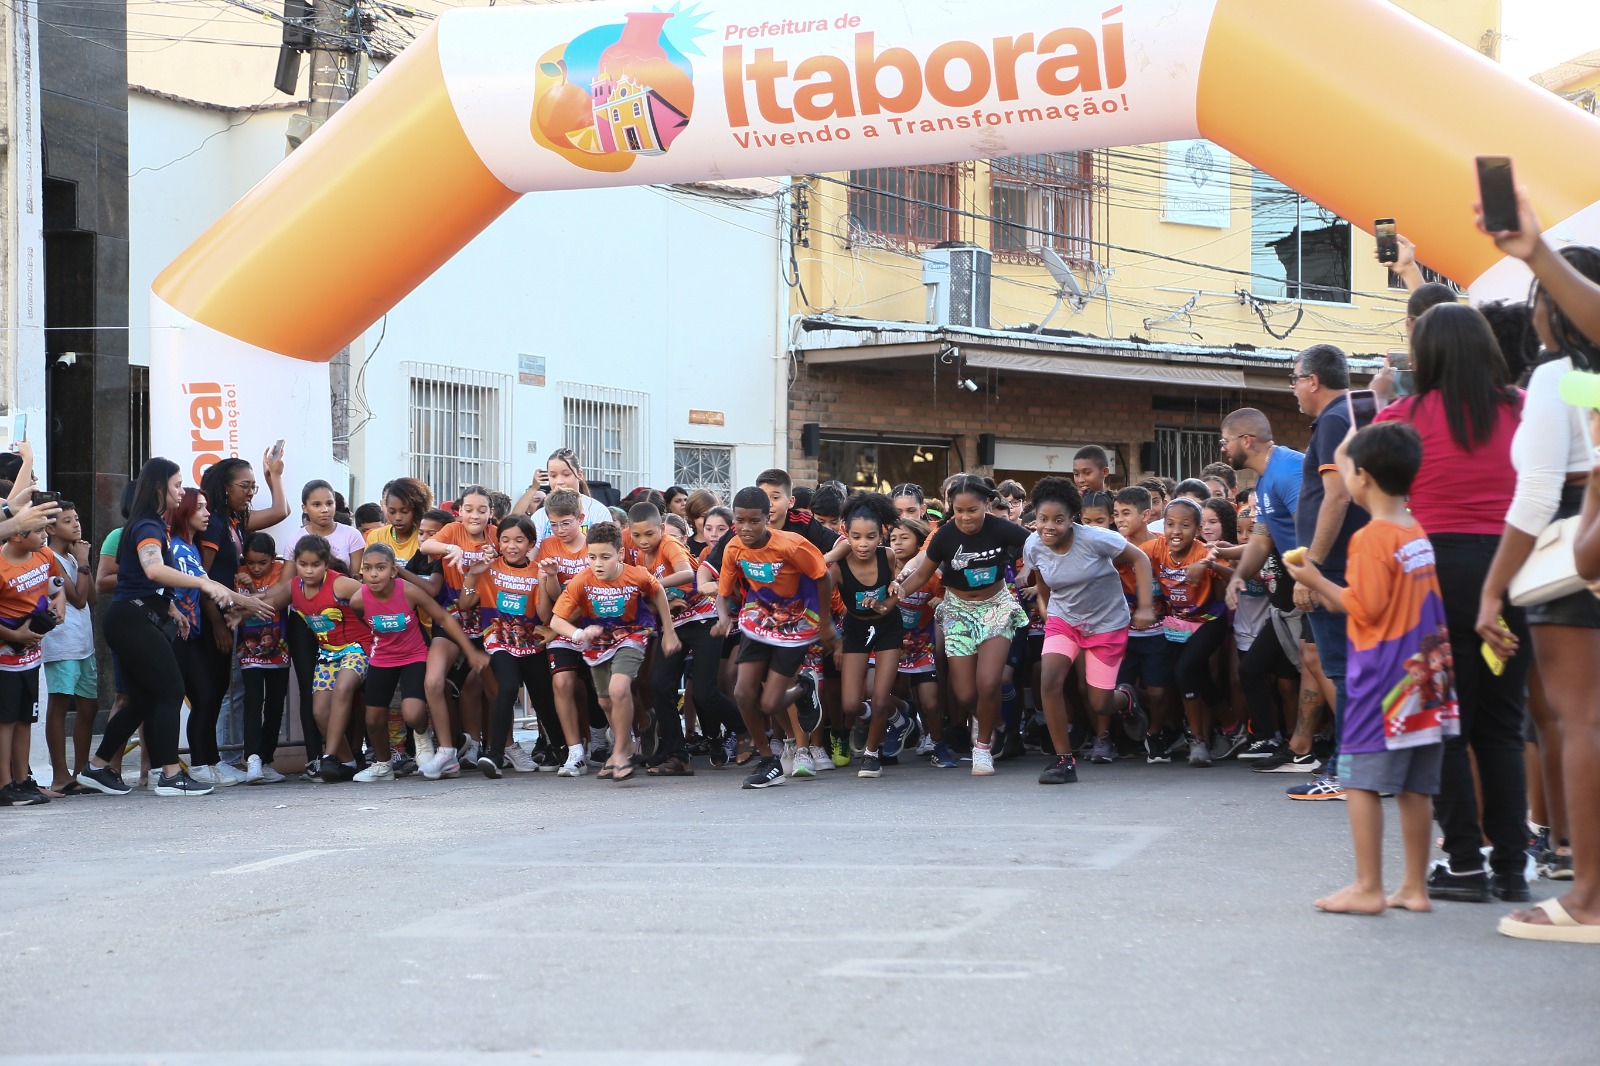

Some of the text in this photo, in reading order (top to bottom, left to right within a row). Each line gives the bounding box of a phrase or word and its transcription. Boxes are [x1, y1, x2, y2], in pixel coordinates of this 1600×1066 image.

[724, 13, 861, 41] Prefeitura de
[722, 4, 1127, 128] Itaboraí
[732, 93, 1130, 149] Vivendo a Transformação!
[181, 382, 224, 488] oraí
[223, 383, 240, 459] ormação!
[502, 600, 520, 609] 078
